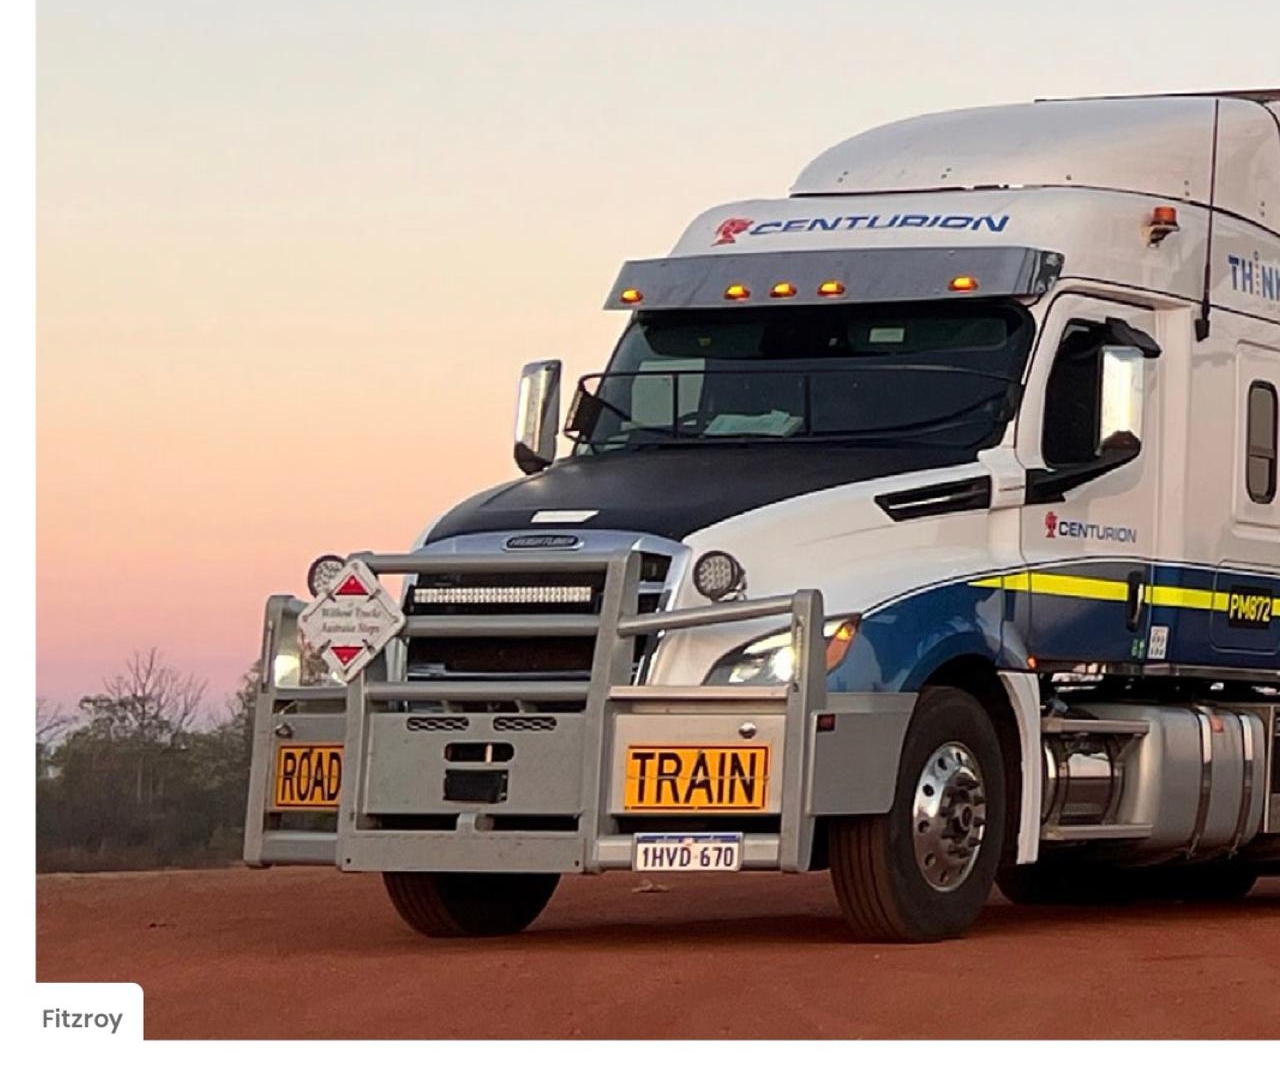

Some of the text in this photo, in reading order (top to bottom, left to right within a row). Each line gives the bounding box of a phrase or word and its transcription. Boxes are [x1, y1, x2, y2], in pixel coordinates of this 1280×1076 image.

[750, 215, 1009, 233] CENTURION
[1059, 521, 1138, 543] CENTURION
[1229, 593, 1272, 623] PM872
[281, 751, 342, 802] ROAD
[632, 752, 756, 804] TRAIN
[643, 847, 735, 868] 1HVD 670
